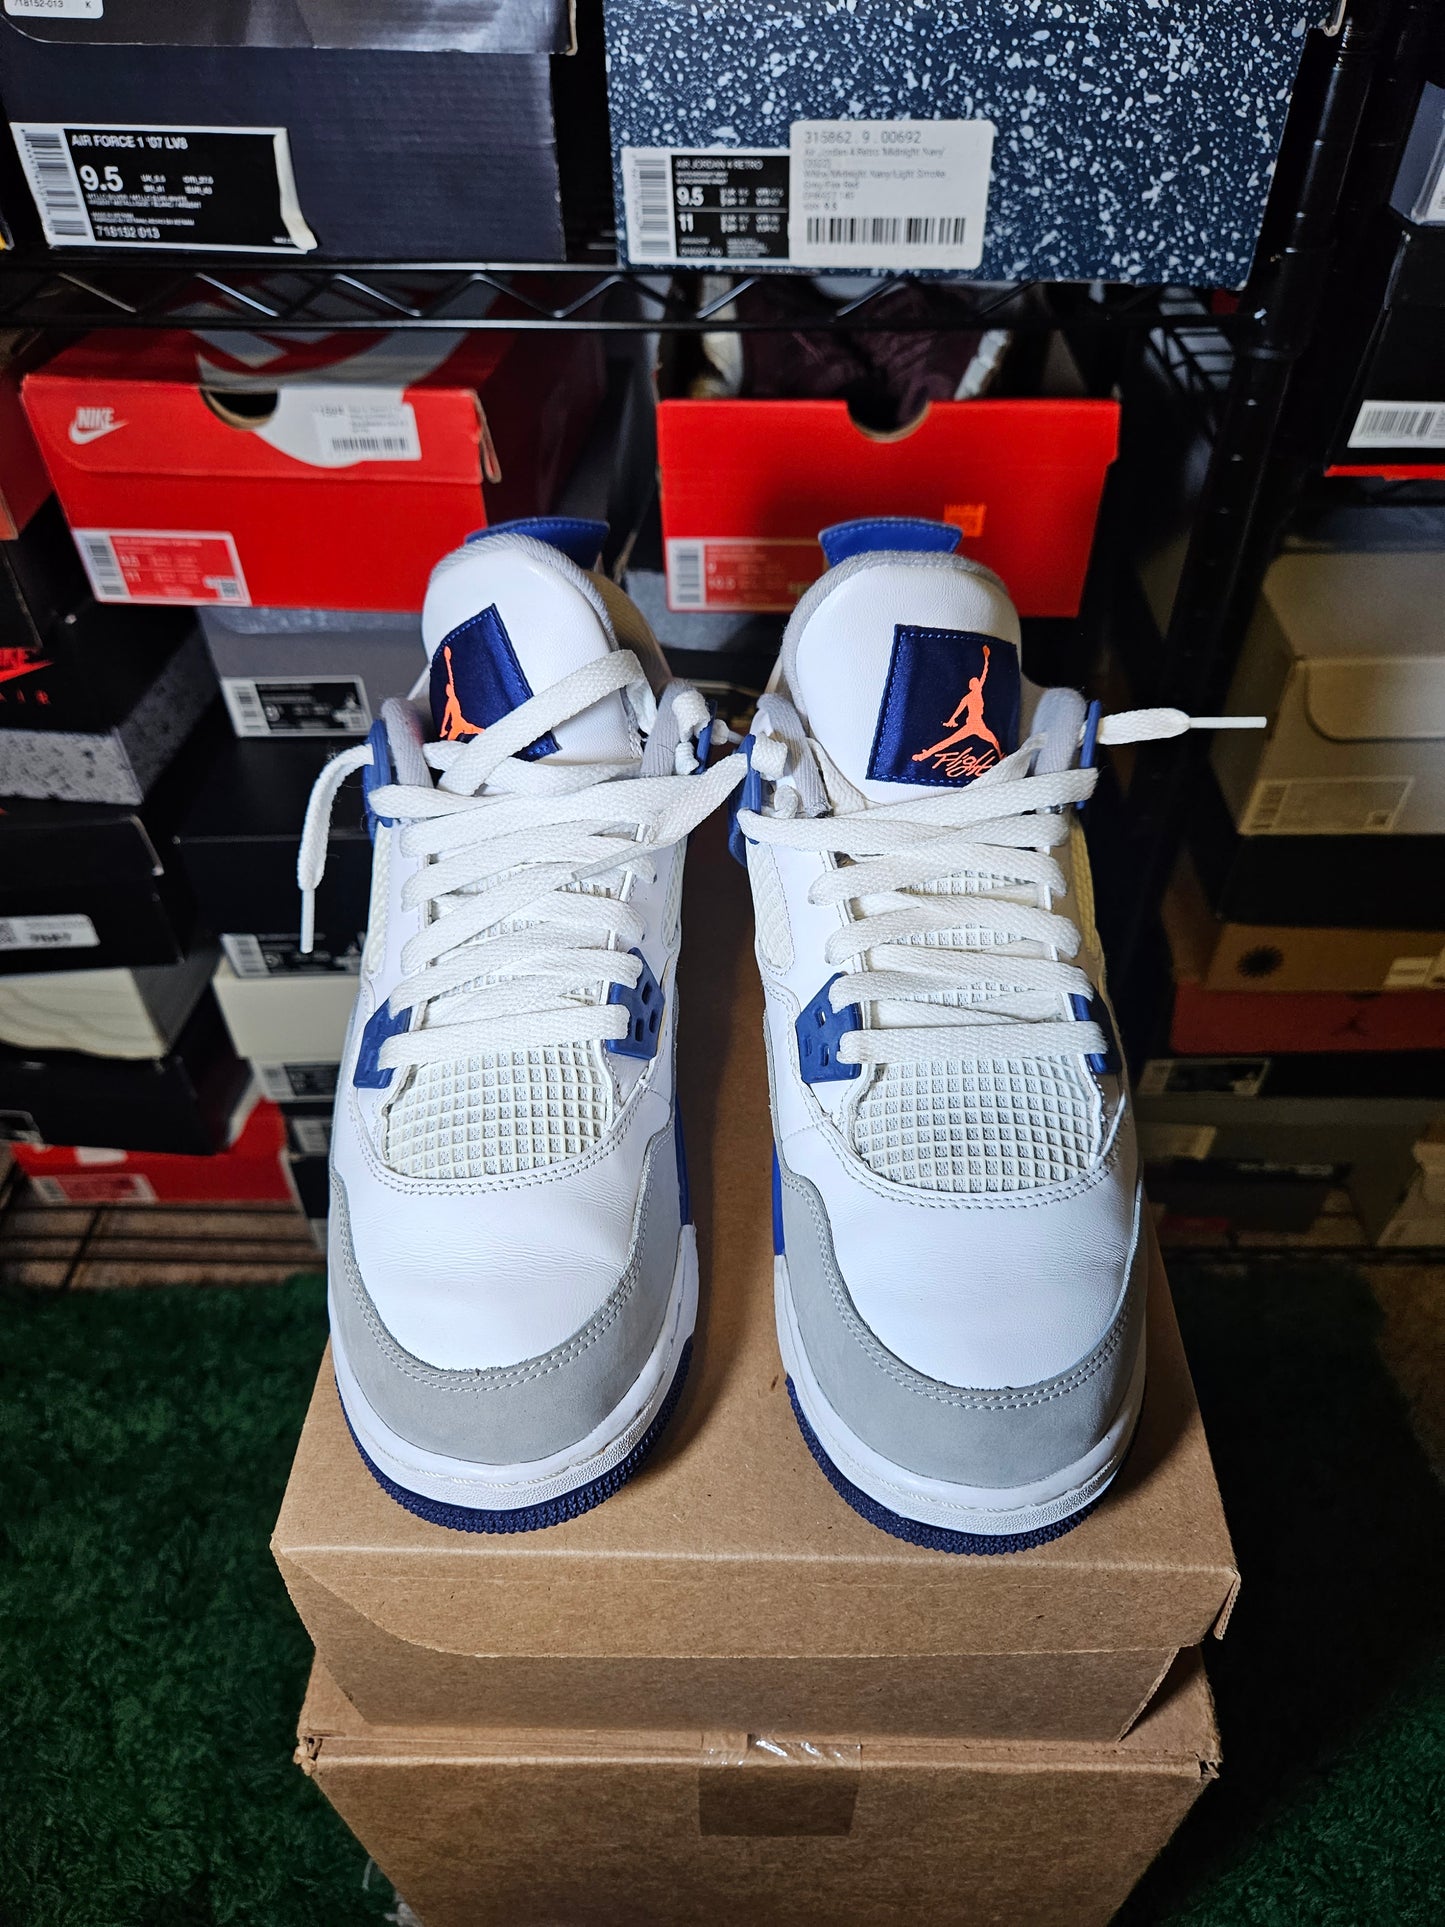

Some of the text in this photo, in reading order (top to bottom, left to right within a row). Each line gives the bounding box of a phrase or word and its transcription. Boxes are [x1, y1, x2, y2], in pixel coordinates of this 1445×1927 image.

[72, 134, 92, 146] AIR
[93, 134, 136, 148] FORCE
[137, 136, 144, 148] 1
[80, 165, 124, 191] 9.5
[676, 186, 705, 206] 9.5
[678, 213, 694, 233] 11
[76, 406, 115, 430] NIKE
